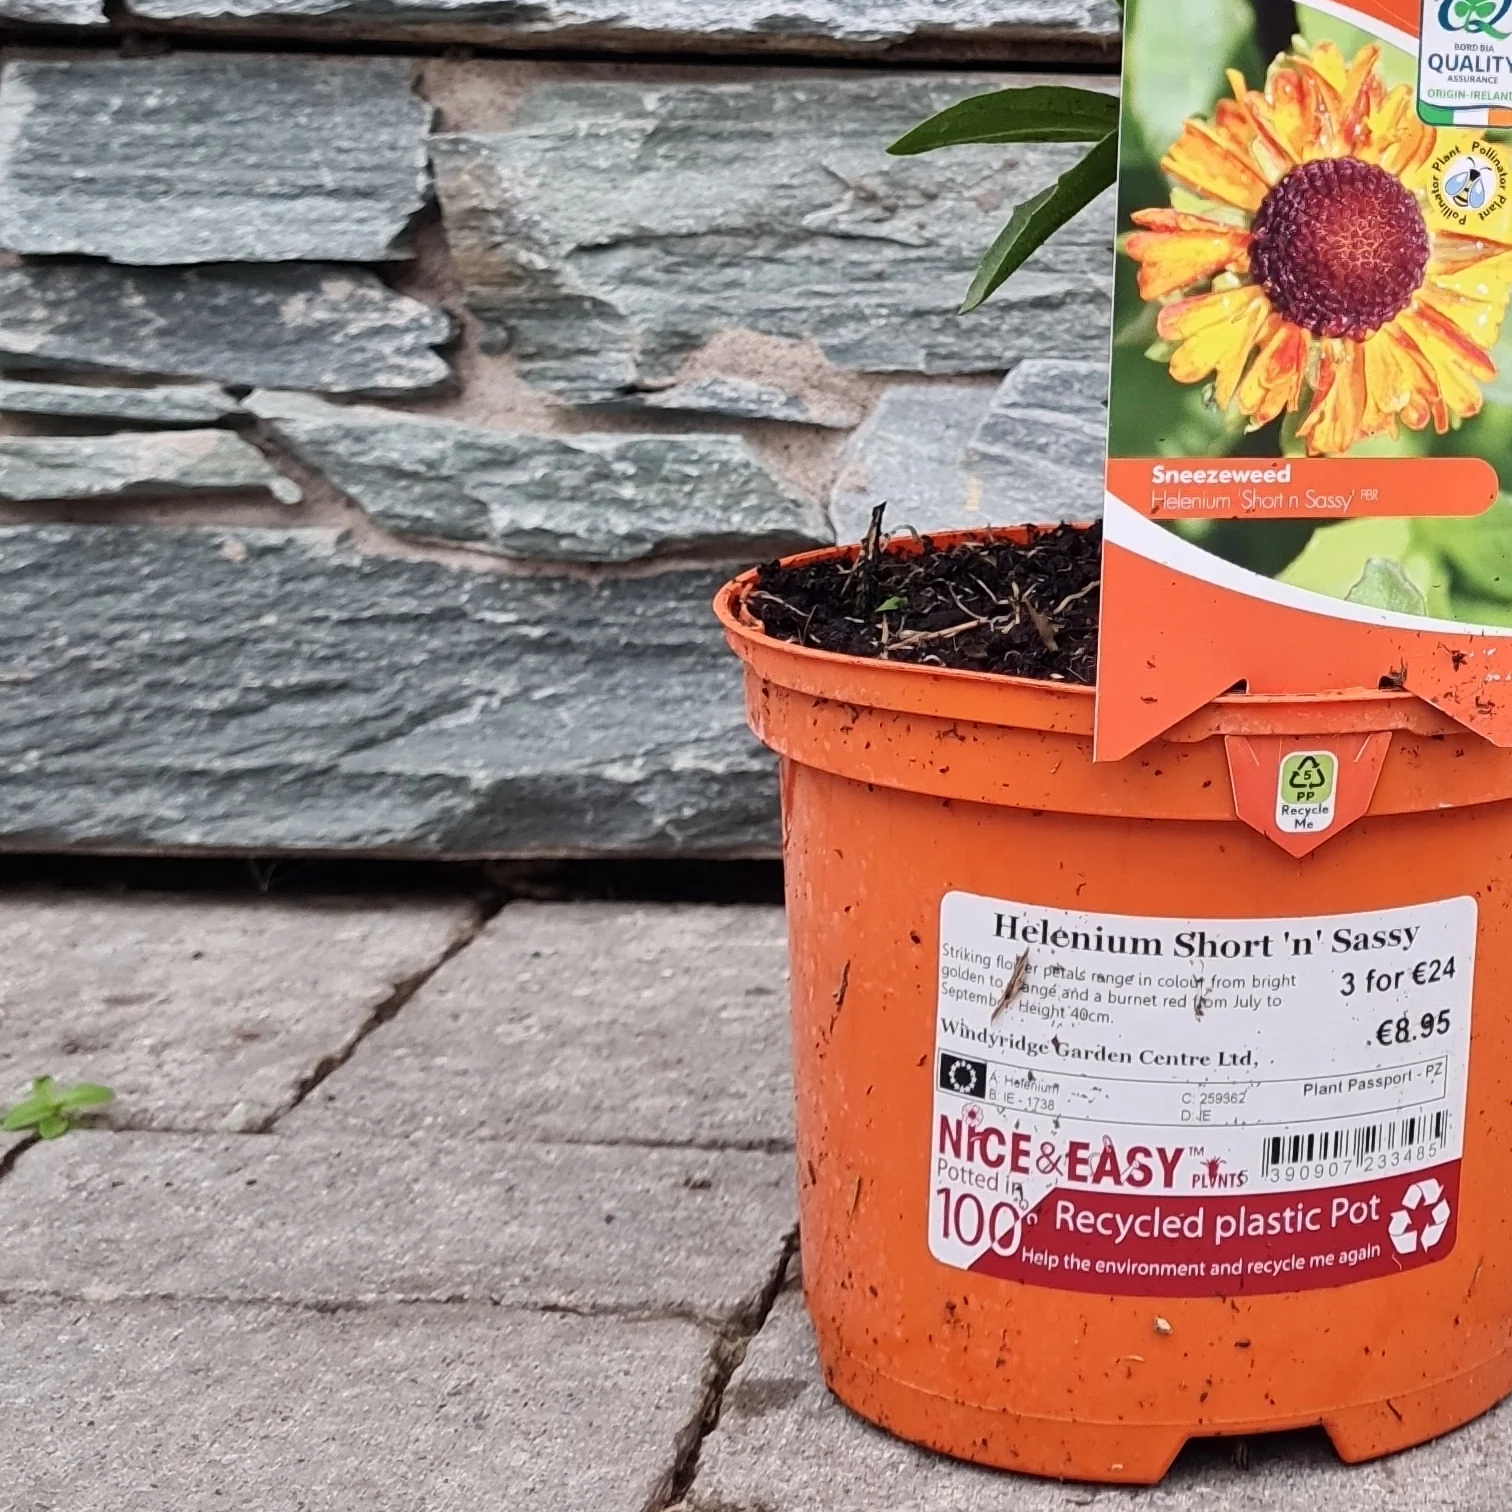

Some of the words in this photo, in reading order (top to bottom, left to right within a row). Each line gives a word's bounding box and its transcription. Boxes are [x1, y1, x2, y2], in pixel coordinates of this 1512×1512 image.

[1454, 43, 1478, 52] BORD
[1480, 44, 1495, 53] BIA
[1447, 75, 1499, 85] ASSURANCE
[1432, 145, 1461, 172] Plant
[1471, 141, 1508, 190] Pollinator
[1431, 175, 1467, 225] Pollinator
[1478, 194, 1507, 221] Plant
[1152, 464, 1291, 484] Sneezeweed
[1152, 490, 1231, 510] Helenium
[1289, 496, 1298, 508] n
[1303, 770, 1312, 780] 5
[1281, 803, 1329, 818] Recycle
[1297, 792, 1315, 801] PP
[1294, 819, 1313, 828] Me
[993, 912, 1163, 957] Helenium
[1174, 931, 1274, 958] Short
[1284, 929, 1322, 956] 'n'
[1332, 925, 1420, 953] Sassy
[942, 942, 991, 969] Striking
[996, 953, 1039, 975] floer
[1043, 966, 1086, 981] petals
[1092, 971, 1134, 988] range
[1139, 972, 1152, 986] in
[1157, 974, 1205, 988] colour
[1211, 974, 1245, 988] from
[1252, 974, 1296, 991] bright
[1340, 972, 1355, 996] 3
[1366, 968, 1404, 993] for
[1412, 956, 1455, 985] €24
[942, 965, 985, 986] golden
[990, 977, 1003, 989] to
[1061, 986, 1088, 1001] and
[1094, 992, 1102, 1002] a
[1108, 989, 1157, 1008] burnet
[1163, 993, 1187, 1008] red
[1234, 994, 1261, 1012] July
[1267, 996, 1282, 1008] to
[1019, 999, 1065, 1020] Height
[1070, 1006, 1114, 1024] 40cm.
[941, 1017, 1049, 1057] Windyridge
[1056, 1042, 1132, 1065] Garden
[1139, 1049, 1211, 1067] Centre
[1376, 1009, 1451, 1046] €8.95
[1005, 1074, 1060, 1095] Helenium
[1303, 1080, 1342, 1097] Plant
[1348, 1069, 1412, 1093] Passport
[1425, 1062, 1443, 1078] PZ
[1003, 1092, 1015, 1104] IE
[1027, 1096, 1055, 1111] 1738
[937, 1157, 999, 1193] Potted
[1005, 1174, 1023, 1197] in
[1270, 1159, 1353, 1184] 390907
[1363, 1143, 1438, 1173] 233485
[1055, 1200, 1204, 1244] Recycled
[1215, 1203, 1321, 1245] plastic
[1331, 1195, 1381, 1228] Pot
[1021, 1246, 1059, 1271] Help
[1063, 1252, 1091, 1272] the
[1095, 1258, 1205, 1276] environment
[1210, 1257, 1243, 1276] and
[1247, 1254, 1305, 1277] recycle
[1309, 1253, 1335, 1268] me
[1339, 1243, 1381, 1267] again
